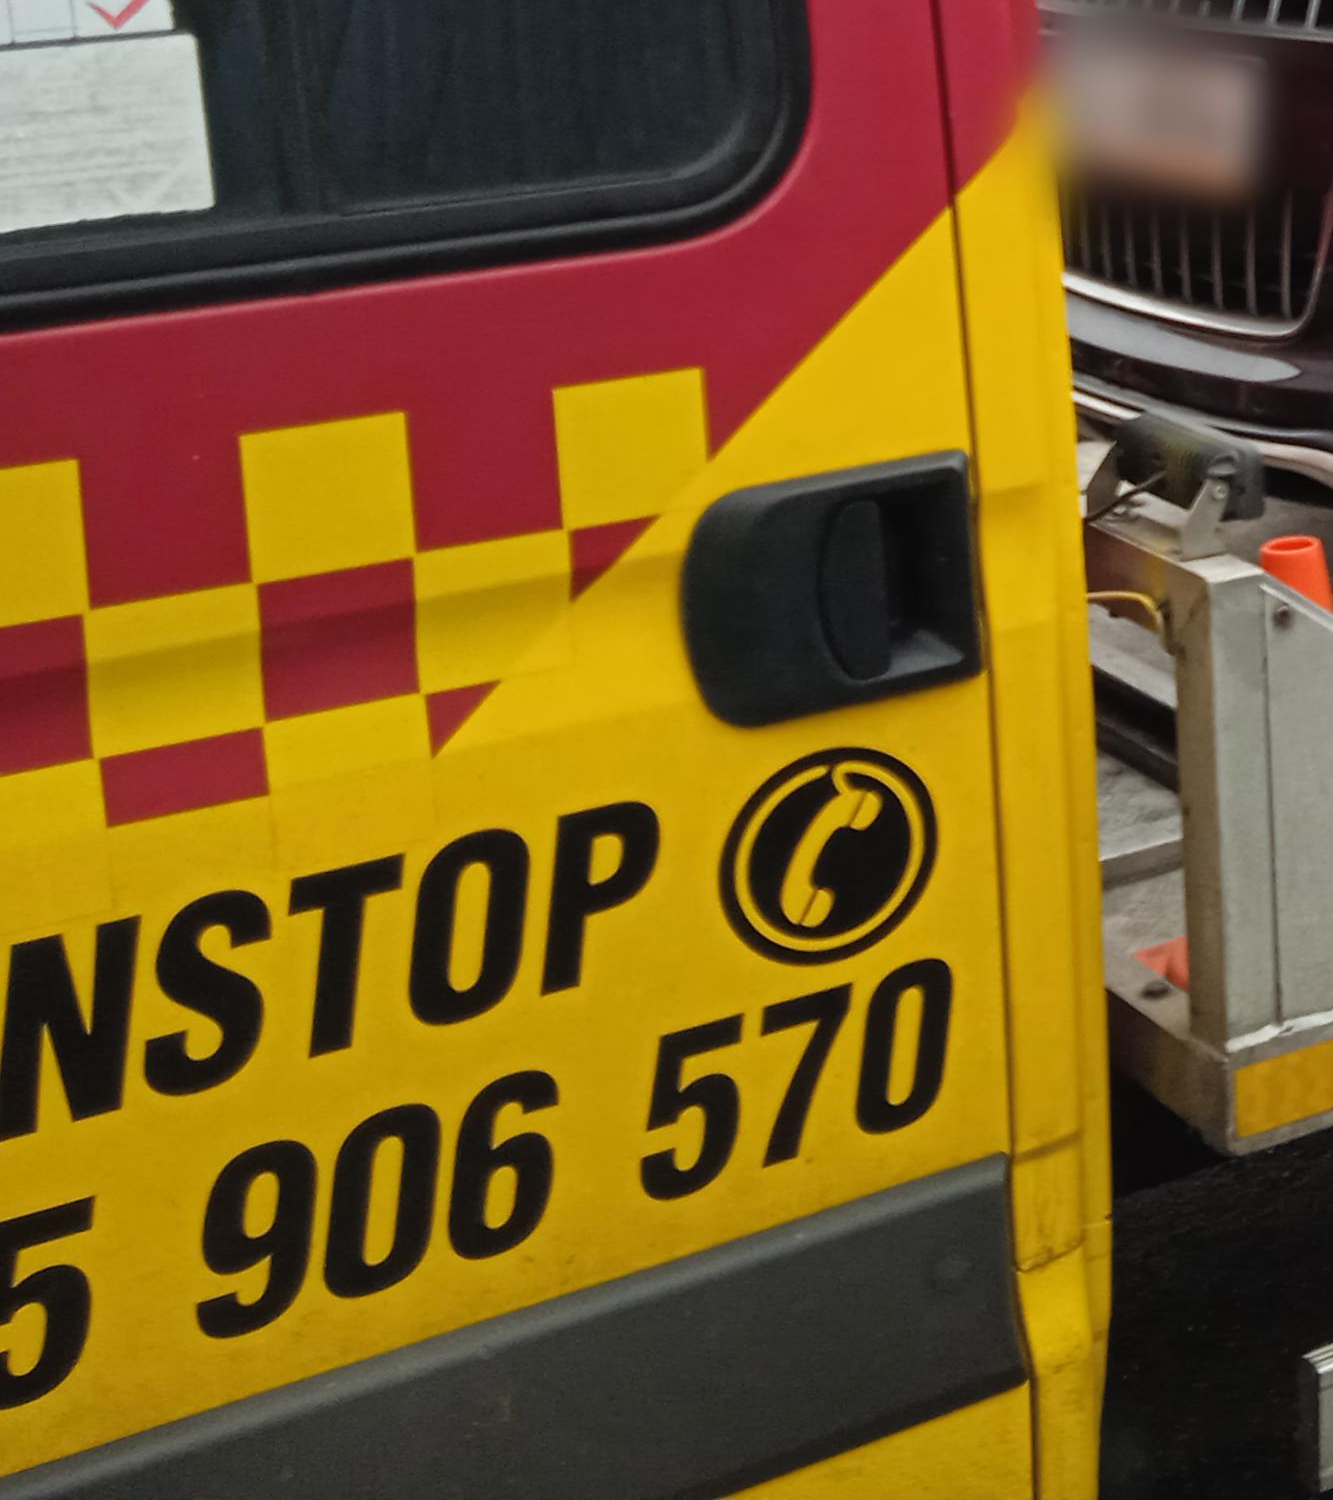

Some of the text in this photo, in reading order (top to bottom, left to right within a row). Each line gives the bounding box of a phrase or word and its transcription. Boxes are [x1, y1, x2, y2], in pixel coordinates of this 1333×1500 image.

[0, 800, 660, 1142] NSTOP
[0, 957, 953, 1411] 5 906 570
